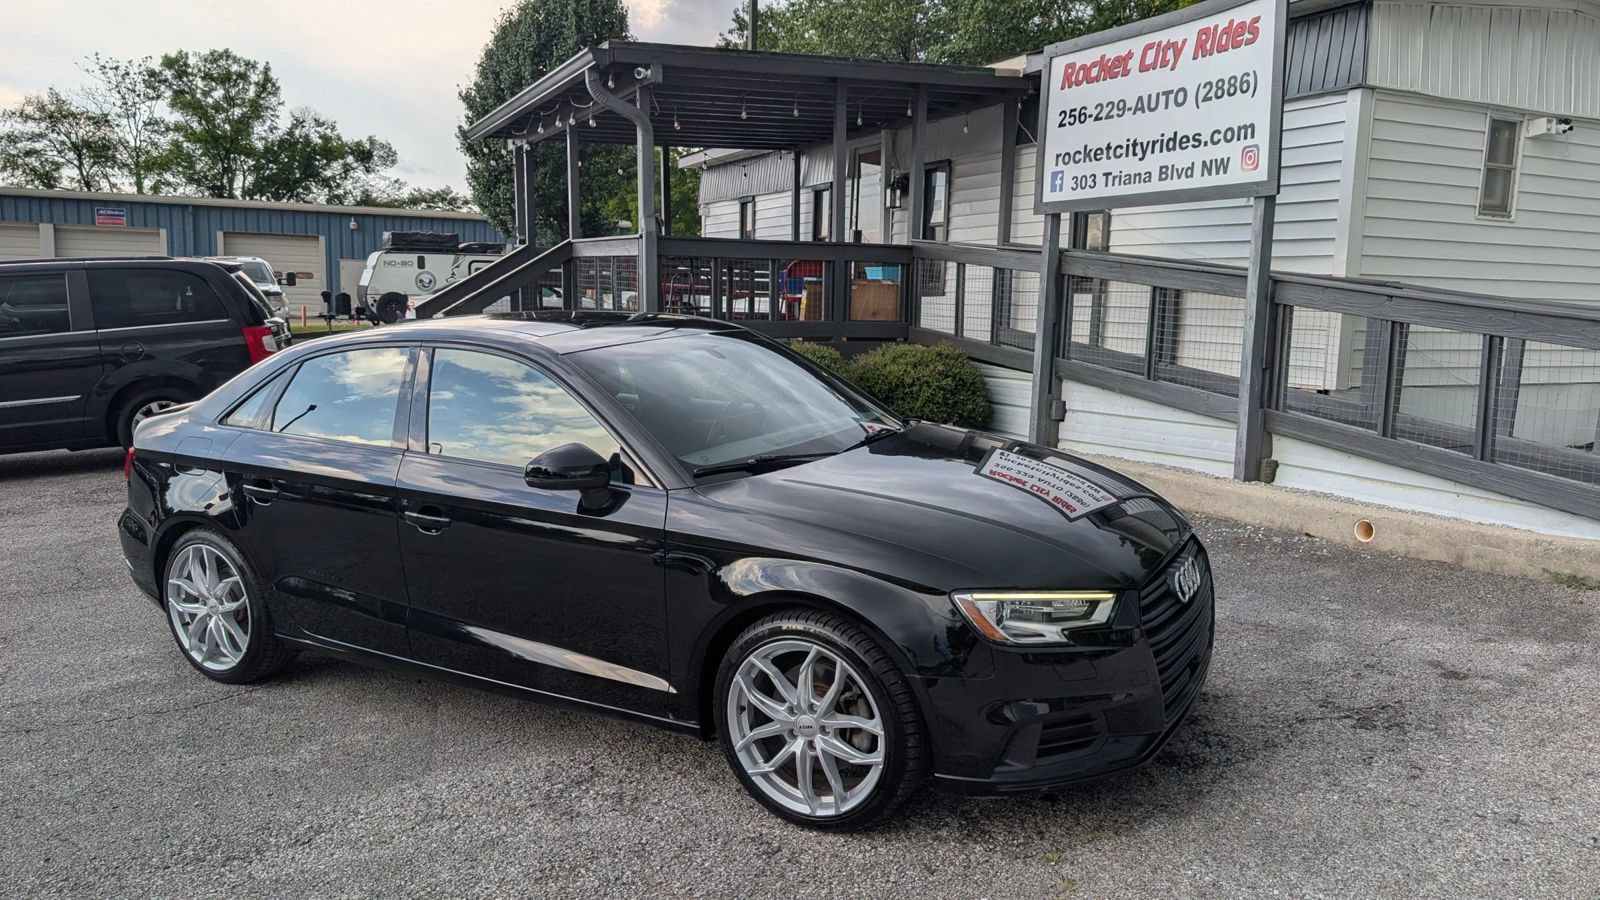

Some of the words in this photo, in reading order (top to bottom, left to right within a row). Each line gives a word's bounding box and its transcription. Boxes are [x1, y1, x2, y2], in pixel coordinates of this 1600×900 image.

[1060, 49, 1135, 90] Rocket
[1138, 38, 1188, 72] City
[1192, 15, 1262, 60] Rides
[1057, 86, 1188, 128] 256-229-AUTO
[1194, 70, 1258, 109] (2886)
[1055, 122, 1256, 167] rocketcityrides.com
[1070, 174, 1097, 191] 303
[1102, 170, 1152, 188] Triana
[1158, 161, 1195, 182] Blvd
[1200, 157, 1231, 178] NW
